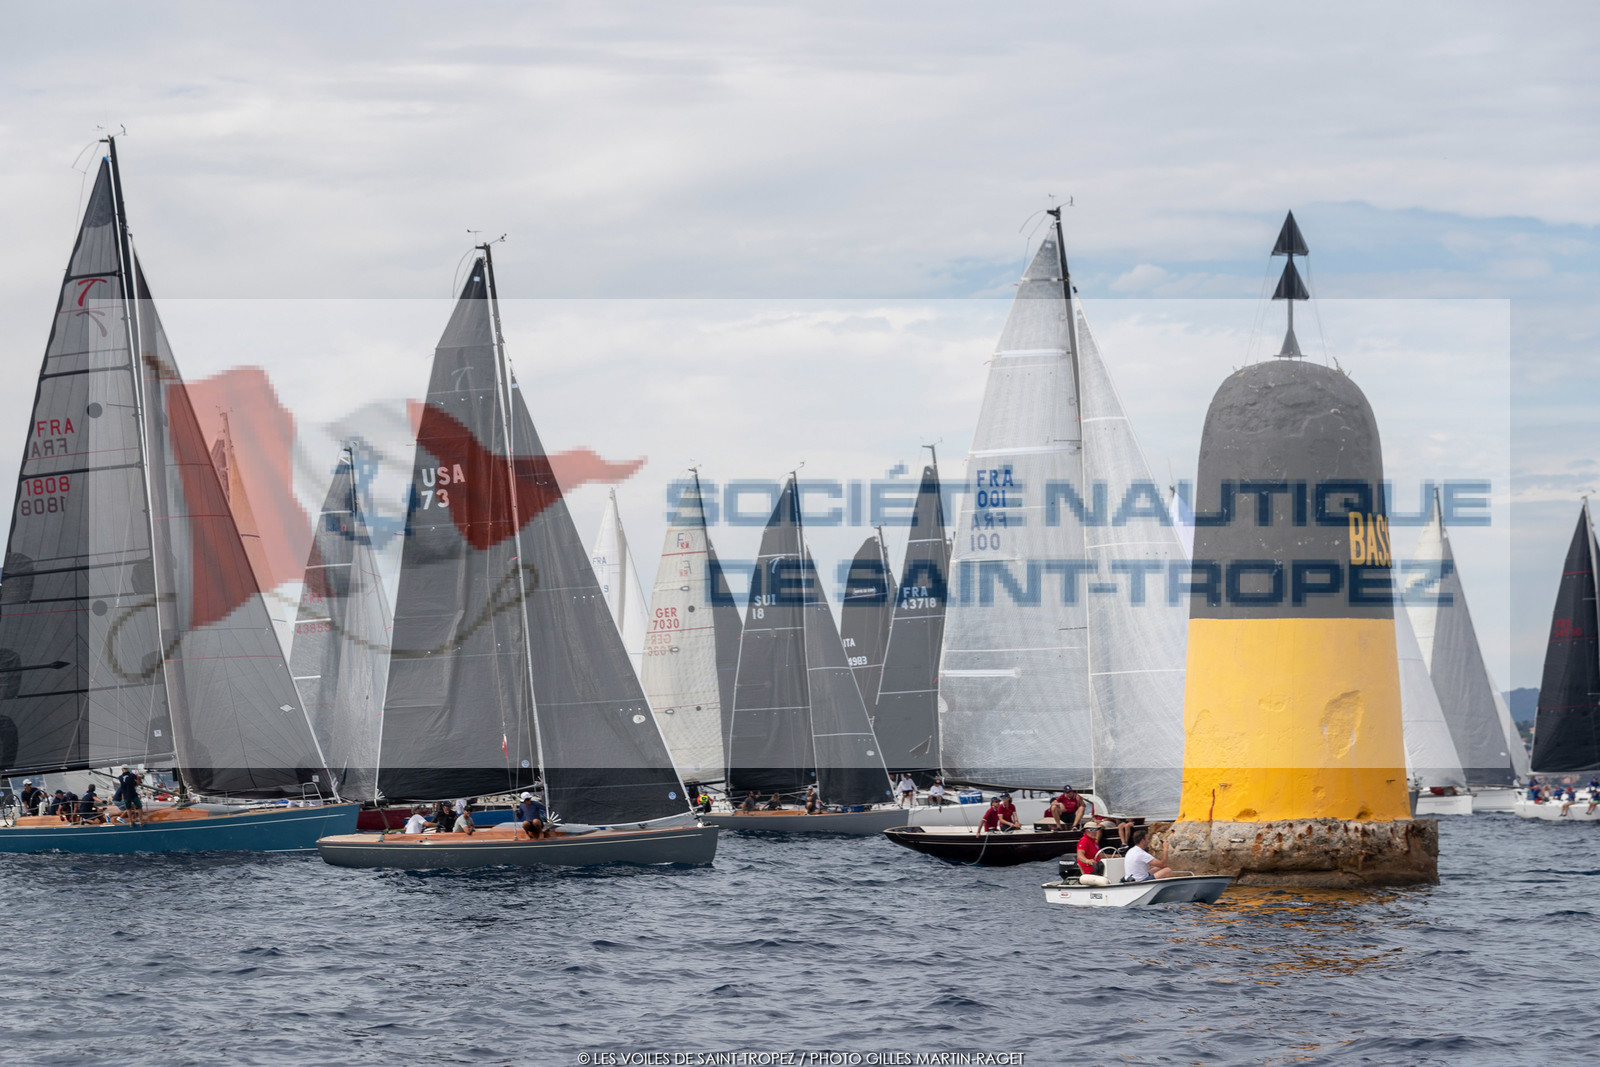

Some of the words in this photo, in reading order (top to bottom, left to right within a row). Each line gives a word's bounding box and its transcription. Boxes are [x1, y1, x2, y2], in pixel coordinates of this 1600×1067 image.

[37, 417, 75, 438] FRA
[421, 463, 466, 488] USA
[976, 469, 1014, 487] FRA
[24, 475, 71, 497] 1808
[421, 488, 450, 511] 73
[592, 556, 607, 565] FRA
[301, 592, 324, 605] FRA
[903, 586, 929, 598] FRA
[754, 594, 777, 607] SUI
[901, 597, 937, 610] 43718
[655, 607, 678, 618] GER
[752, 608, 765, 620] 18
[296, 622, 331, 635] 43859
[653, 618, 680, 631] 7030
[843, 638, 856, 648] ITA
